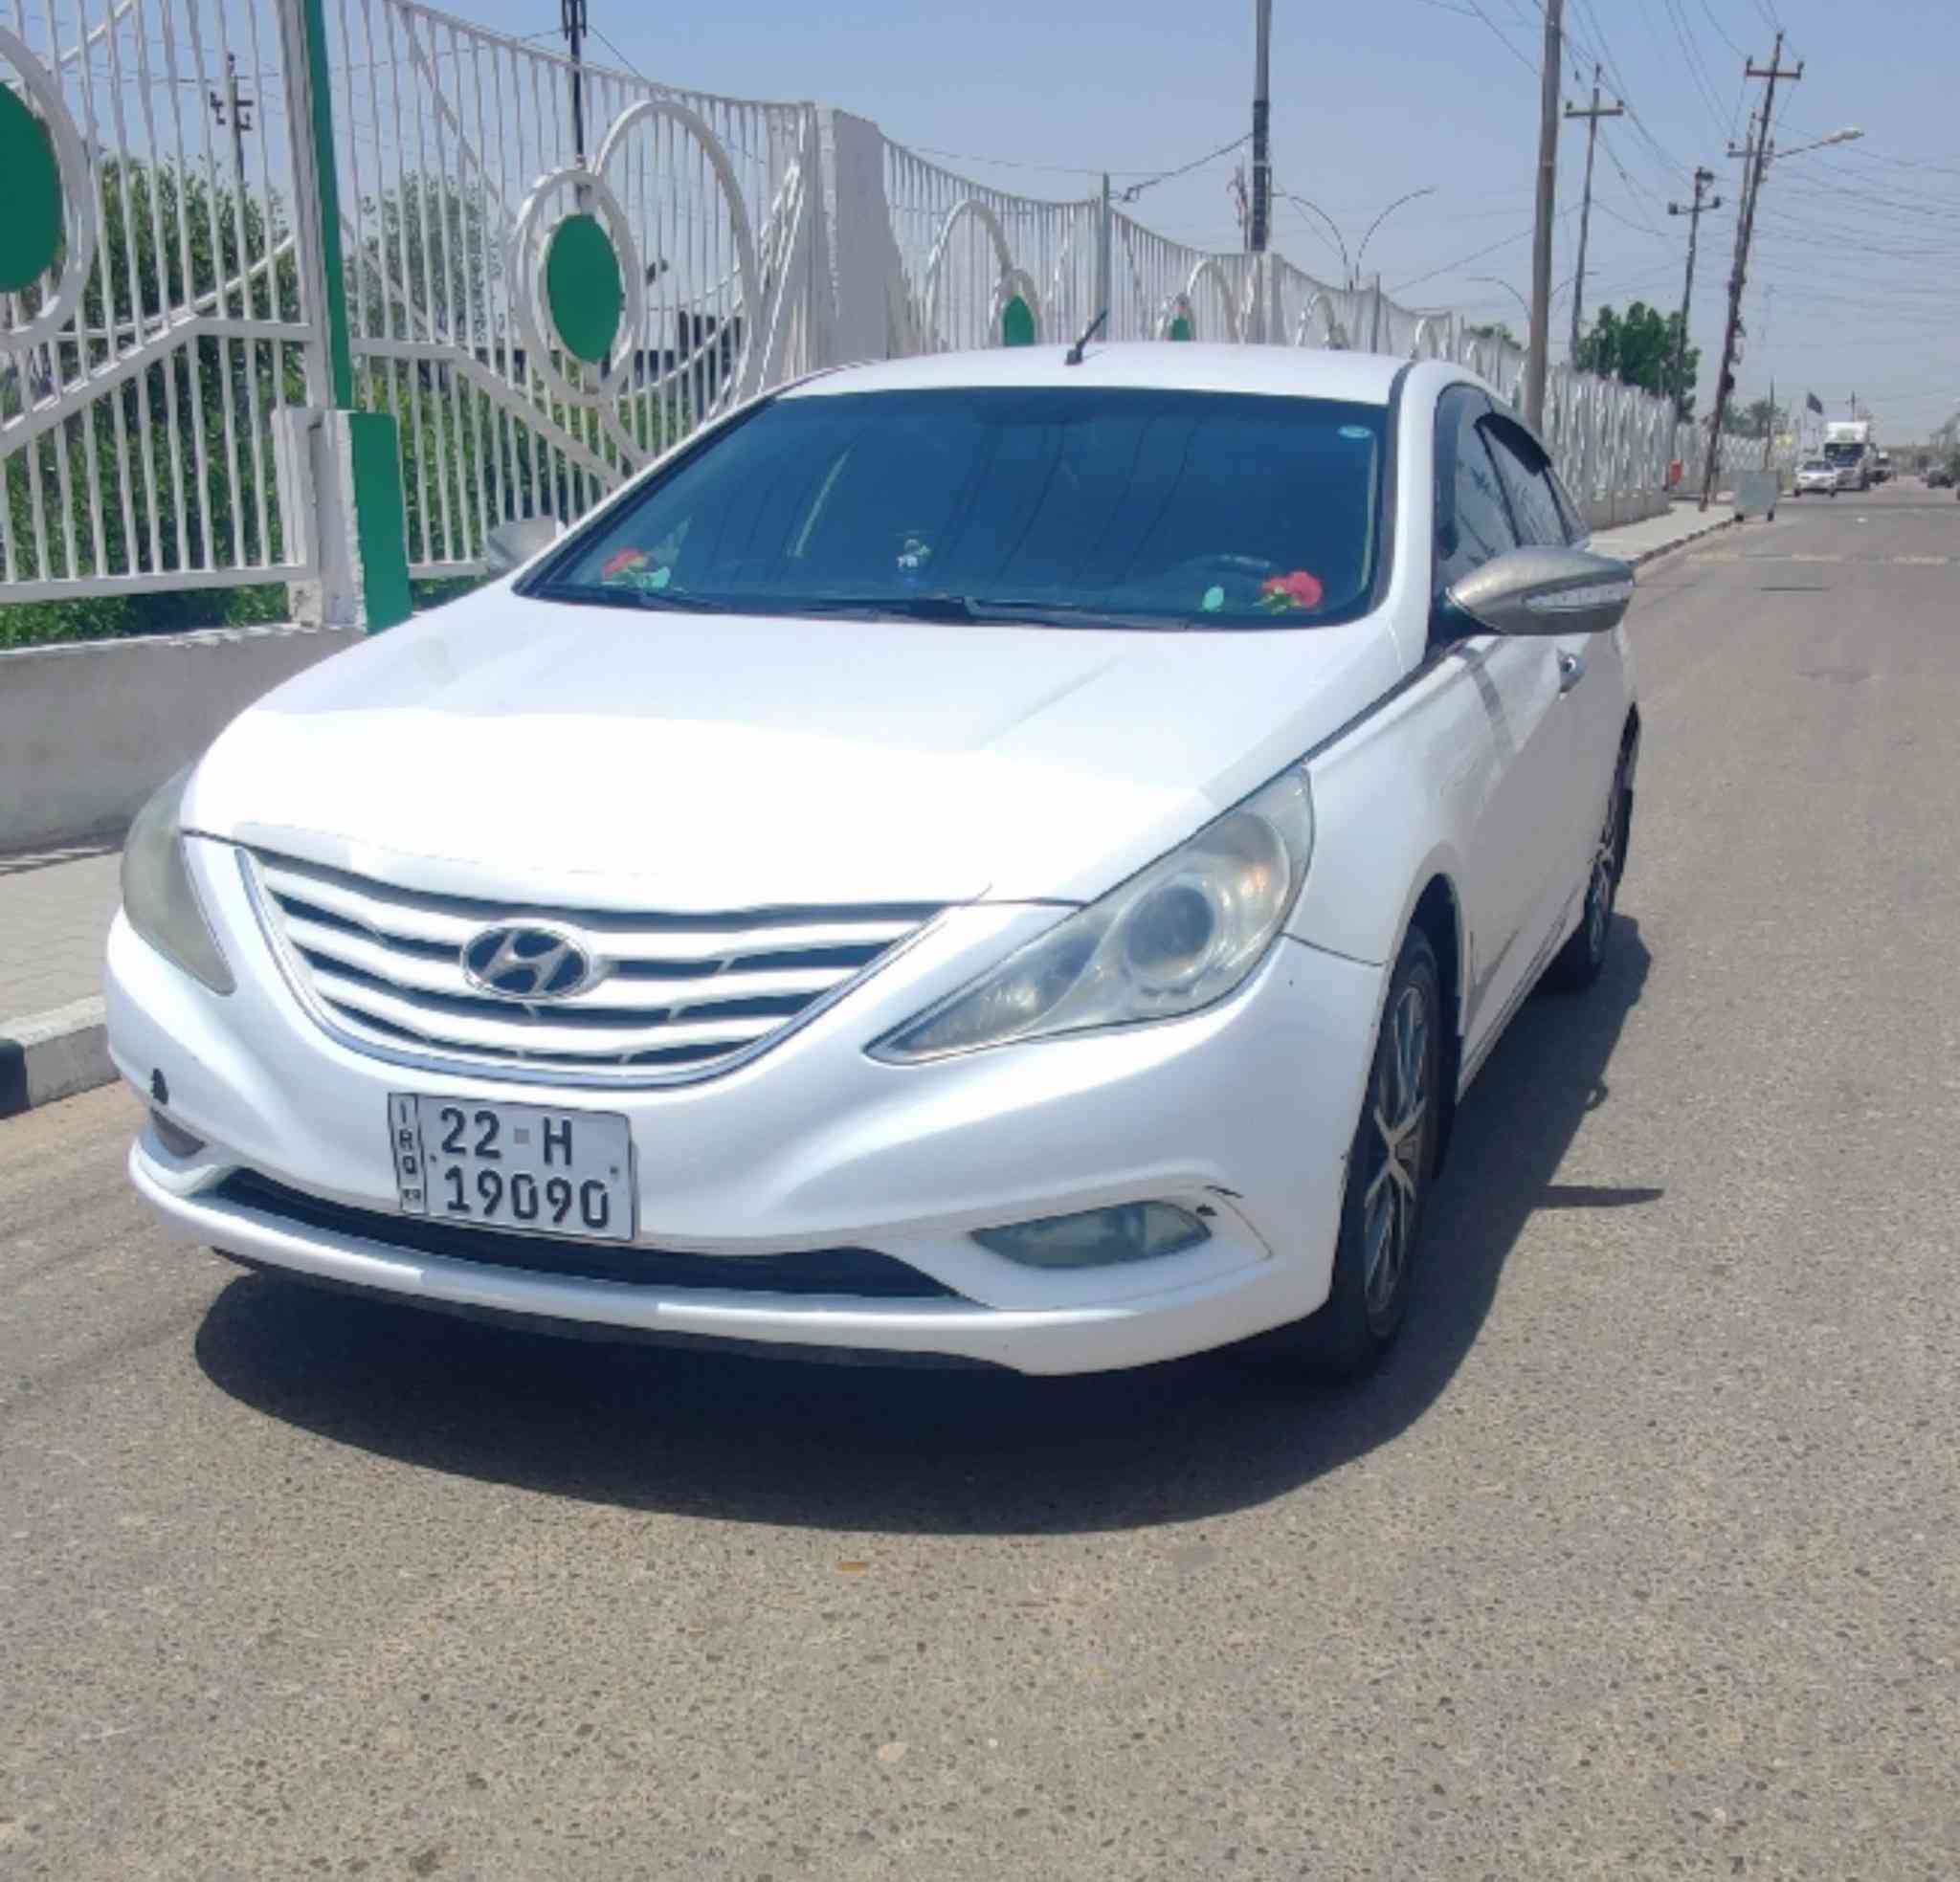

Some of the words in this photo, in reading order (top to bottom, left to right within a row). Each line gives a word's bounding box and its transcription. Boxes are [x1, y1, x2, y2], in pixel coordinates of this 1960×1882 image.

[440, 1107, 501, 1159] 22
[543, 1116, 572, 1165] H
[444, 1164, 610, 1228] 19090
